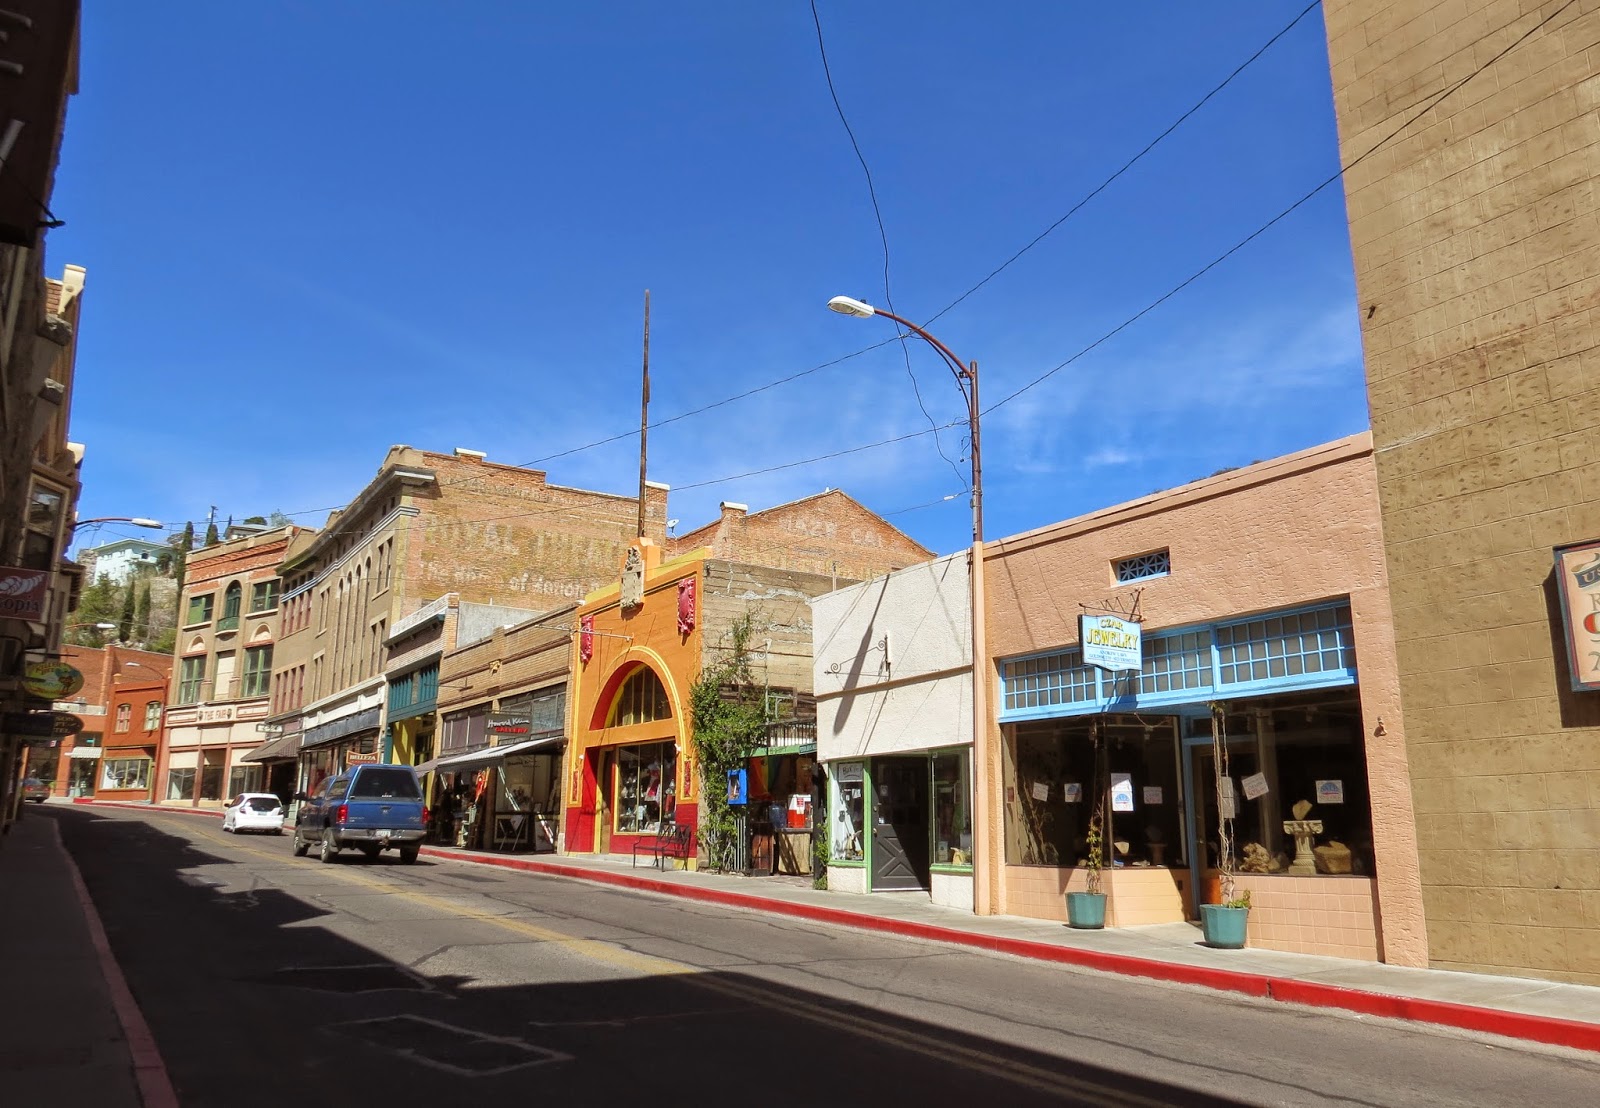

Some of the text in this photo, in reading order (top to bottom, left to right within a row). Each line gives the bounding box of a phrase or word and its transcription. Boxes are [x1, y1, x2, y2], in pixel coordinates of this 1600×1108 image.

[1087, 629, 1138, 650] JEWELRY
[204, 708, 227, 721] THE FAIR
[495, 726, 529, 734] GALLERY
